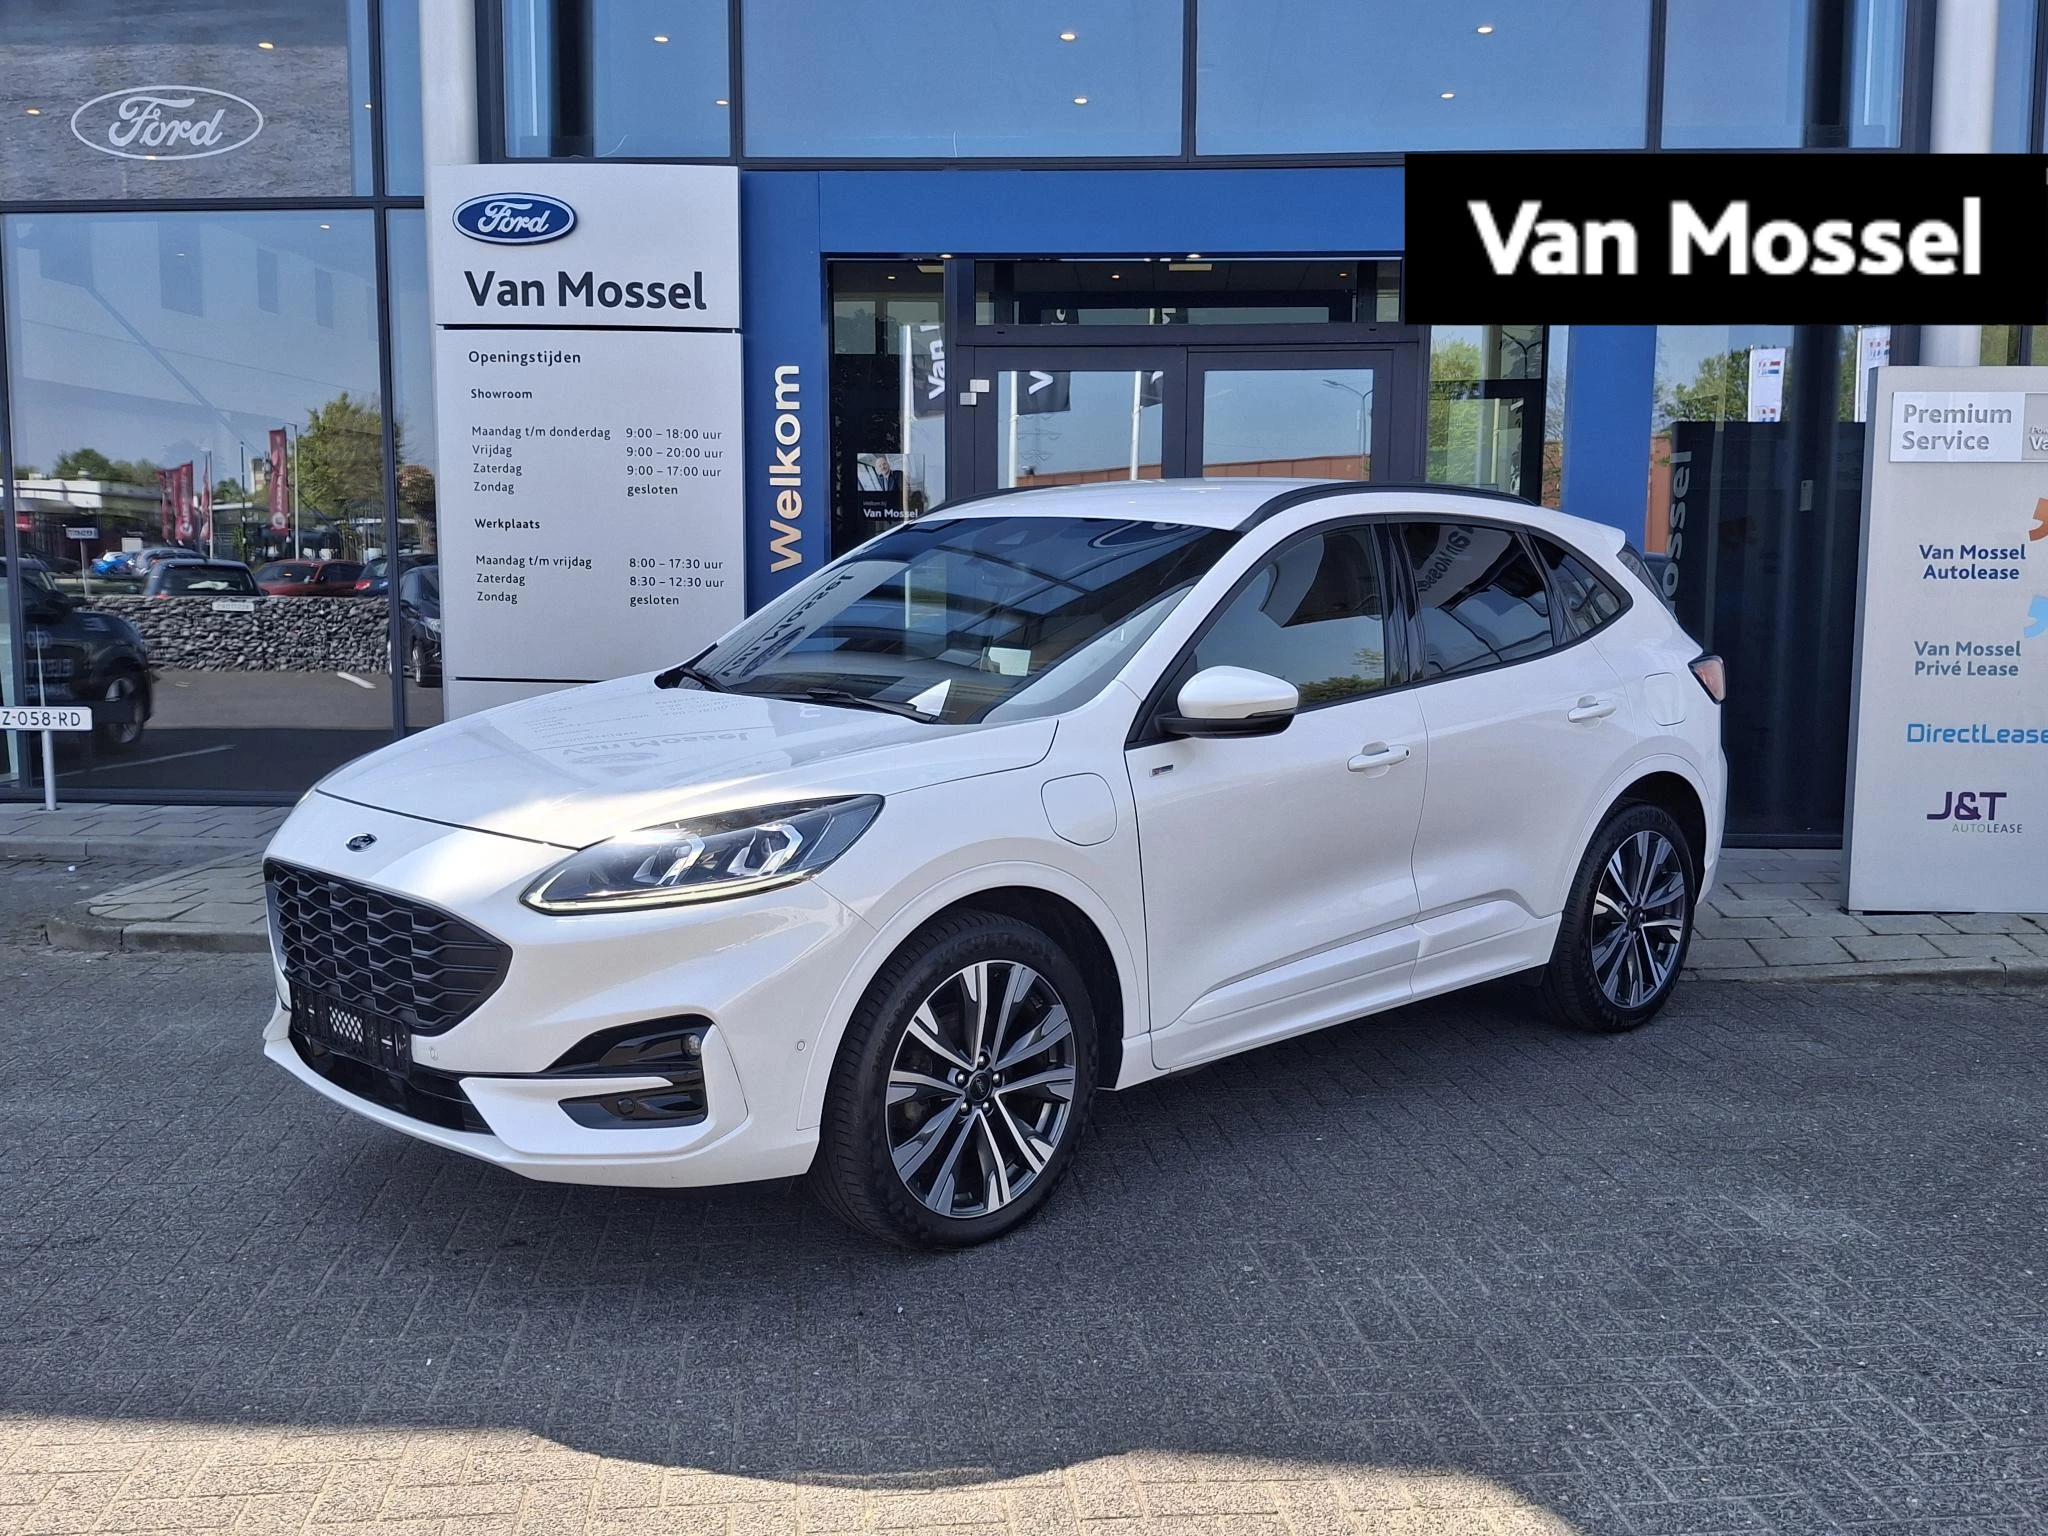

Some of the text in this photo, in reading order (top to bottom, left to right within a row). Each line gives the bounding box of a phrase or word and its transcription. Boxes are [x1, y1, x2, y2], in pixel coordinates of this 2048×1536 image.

[109, 96, 225, 146] Ford
[477, 202, 551, 233] Ford
[464, 270, 707, 310] Van Mossel
[469, 350, 581, 367] Openingstijden
[471, 388, 533, 399] Showroom
[1903, 403, 2012, 424] Premium
[472, 425, 522, 440] Maandag
[526, 425, 546, 437] t/m
[550, 426, 611, 441] donderdag
[626, 427, 653, 439] 9:00
[666, 428, 699, 440] 18:00
[703, 431, 722, 440] uur
[1901, 430, 1990, 450] Service
[473, 444, 513, 458] Vrijdag
[627, 446, 653, 457] 9:00
[667, 447, 701, 458] 20:00
[705, 450, 723, 459] uur
[474, 462, 523, 477] Zaterdag
[627, 465, 654, 476] 9:00
[667, 466, 699, 477] 17:00
[703, 469, 721, 477] uur
[769, 365, 802, 573] Welkom
[474, 481, 678, 497] Zondag gesloten
[863, 508, 918, 518] Van Mossel
[475, 518, 541, 532] Werkplaats
[1919, 544, 2026, 560] Van Mossel
[476, 554, 526, 569] Maandag
[529, 555, 550, 566] t/m
[553, 556, 592, 570] vrijdag
[630, 557, 656, 568] 8:00
[669, 558, 701, 569] 17:30
[705, 561, 723, 570] uur
[1923, 564, 2020, 579] Autolease
[477, 573, 526, 587] Zaterdag
[630, 575, 656, 587] 8:30
[670, 576, 702, 588] 12:30
[706, 580, 725, 588] uur
[478, 591, 679, 608] Zondag gesloten
[1914, 640, 2021, 657] Van Mossel
[1915, 660, 2019, 676] Privé Lease
[2, 711, 81, 726] Z-058-RD
[1907, 723, 2048, 743] DirectLease
[1927, 791, 2007, 820] J&T
[1951, 823, 2023, 833] AUTOLEASE
